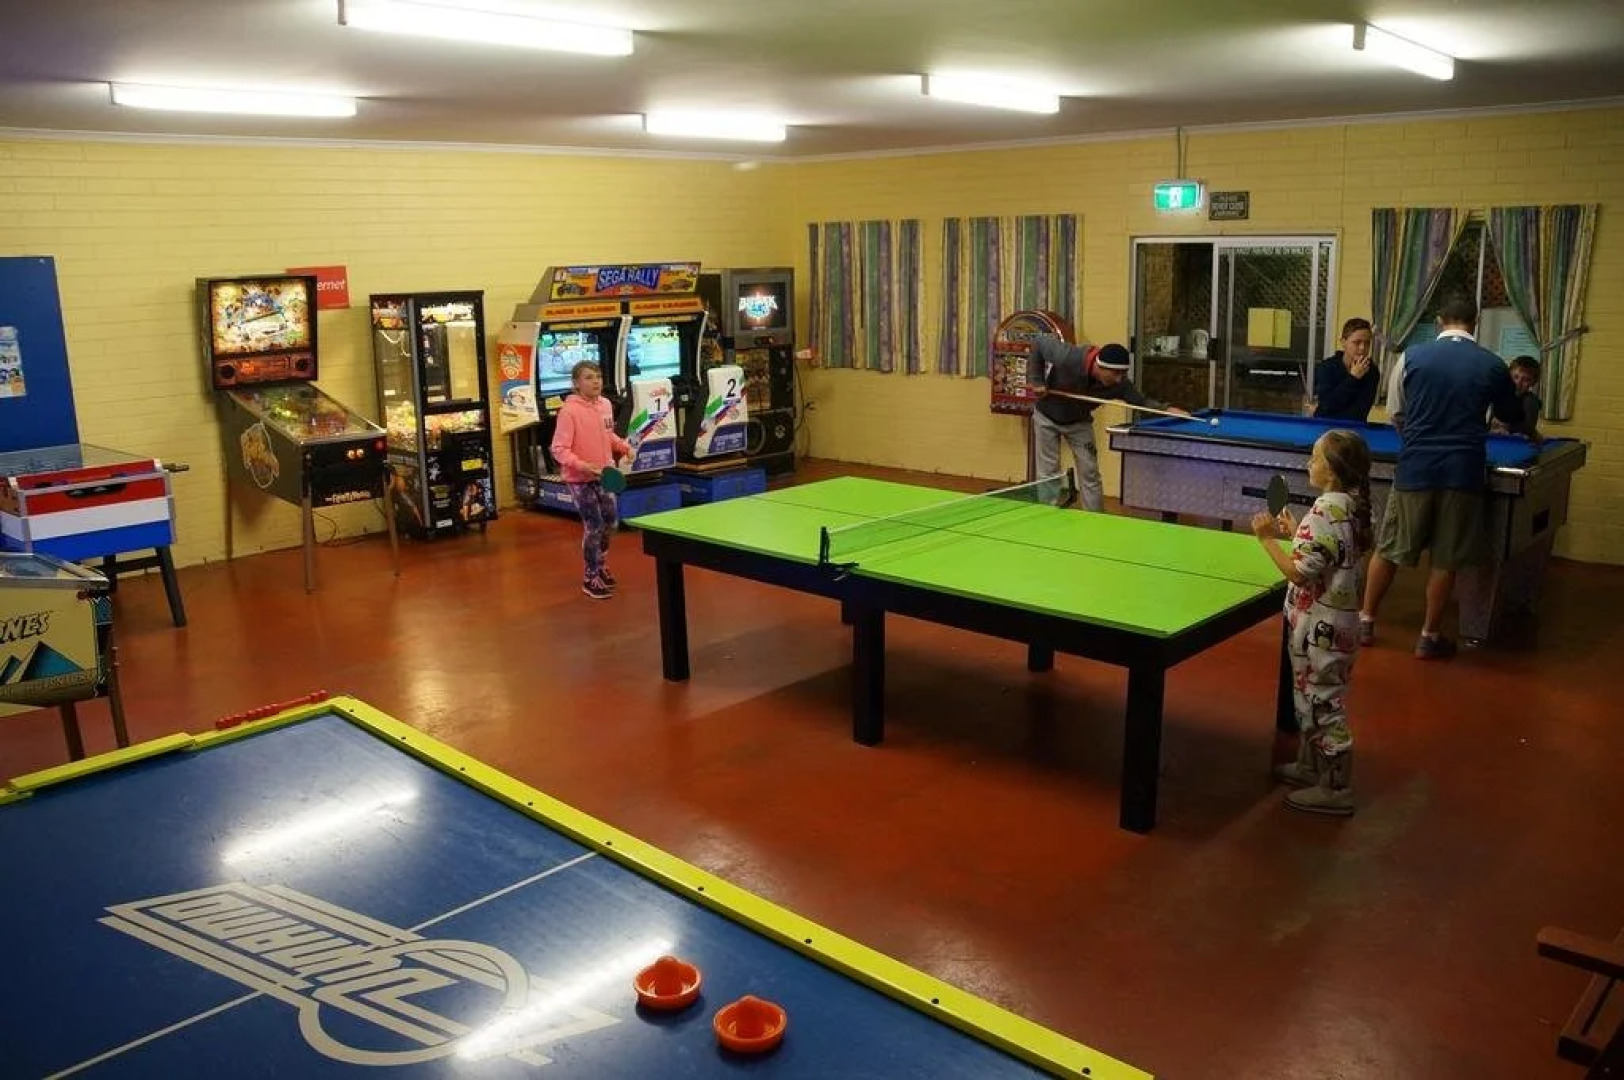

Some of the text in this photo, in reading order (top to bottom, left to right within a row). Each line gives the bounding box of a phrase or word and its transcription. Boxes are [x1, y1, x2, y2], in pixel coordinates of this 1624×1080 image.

[316, 279, 346, 291] ernet
[599, 269, 625, 285] SEGA
[628, 268, 658, 287] RALLY
[727, 378, 737, 397] 2
[654, 397, 661, 412] 1
